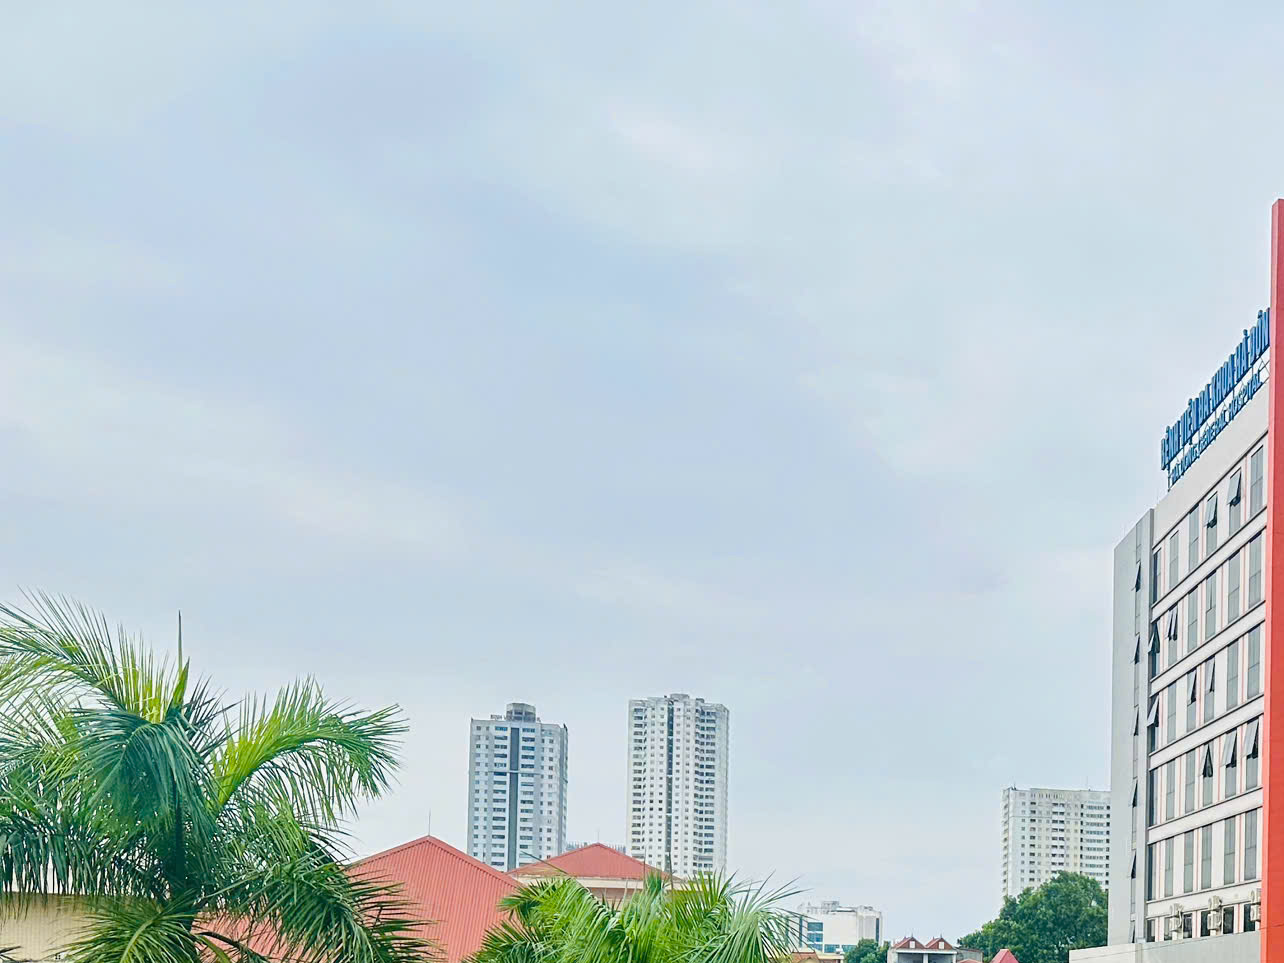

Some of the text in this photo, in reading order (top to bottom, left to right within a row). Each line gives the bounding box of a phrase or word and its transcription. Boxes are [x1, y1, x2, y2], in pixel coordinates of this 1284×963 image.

[1211, 353, 1235, 411] KHOA
[1249, 307, 1270, 367] ĐÔN
[1229, 369, 1263, 421] HOSPITAL
